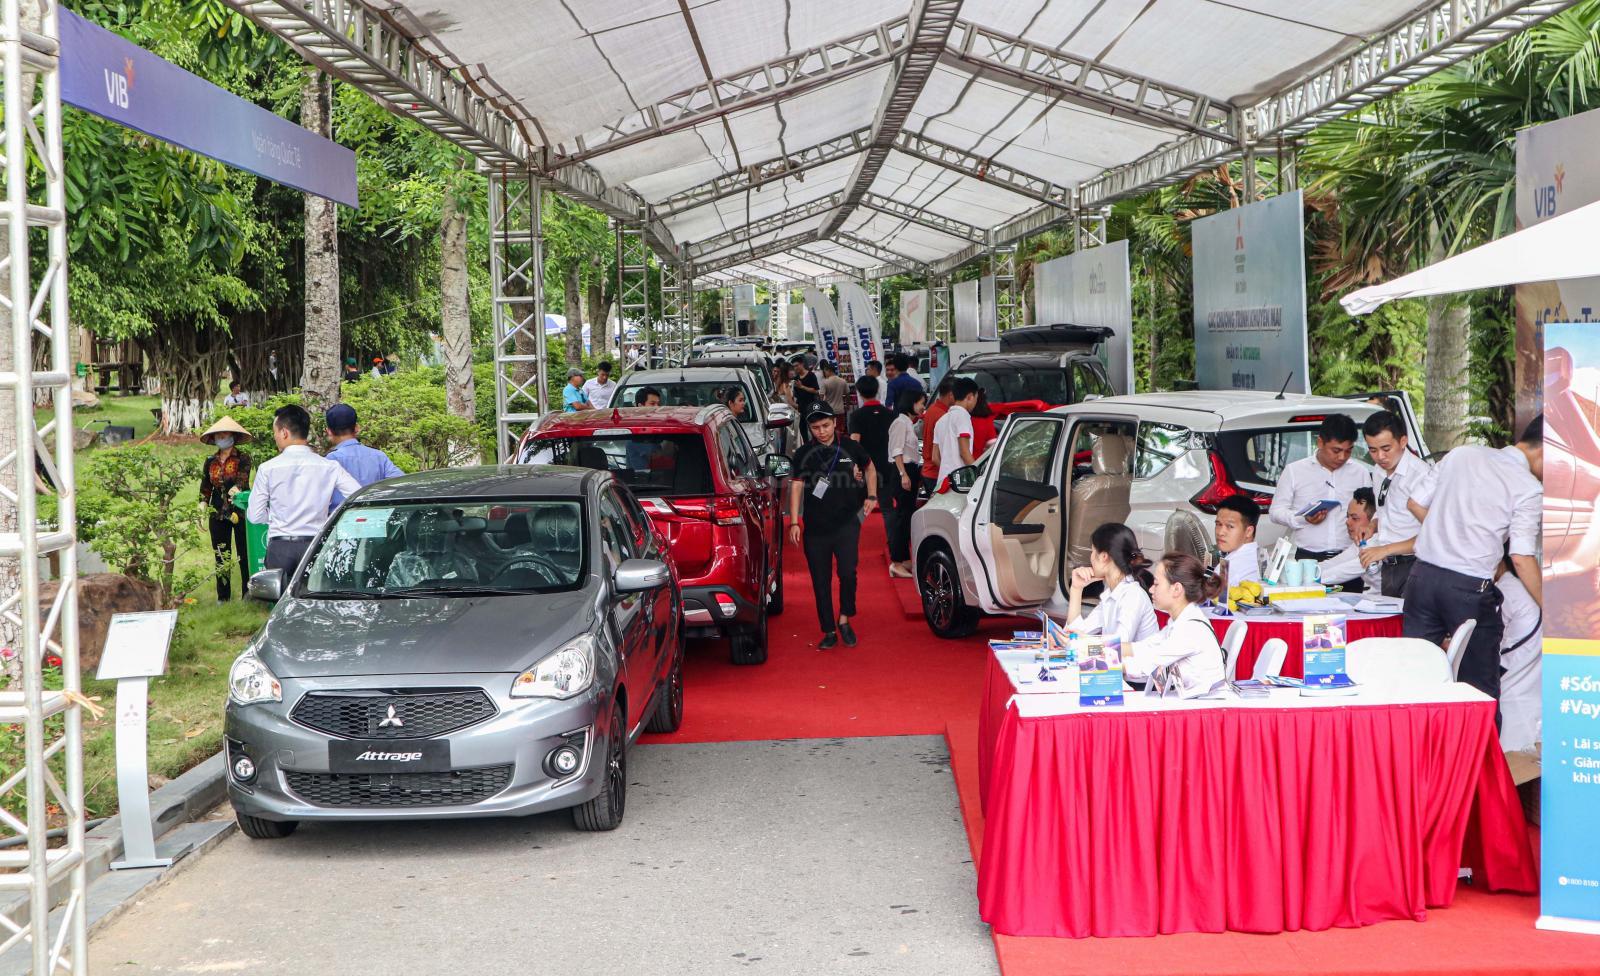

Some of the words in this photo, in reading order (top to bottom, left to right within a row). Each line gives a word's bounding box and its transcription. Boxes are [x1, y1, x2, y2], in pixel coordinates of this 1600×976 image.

[104, 68, 129, 109] VIB
[1534, 185, 1556, 218] VIB
[1560, 699, 1600, 719] #Vay
[355, 751, 423, 762] Attrage
[1573, 772, 1591, 783] khi
